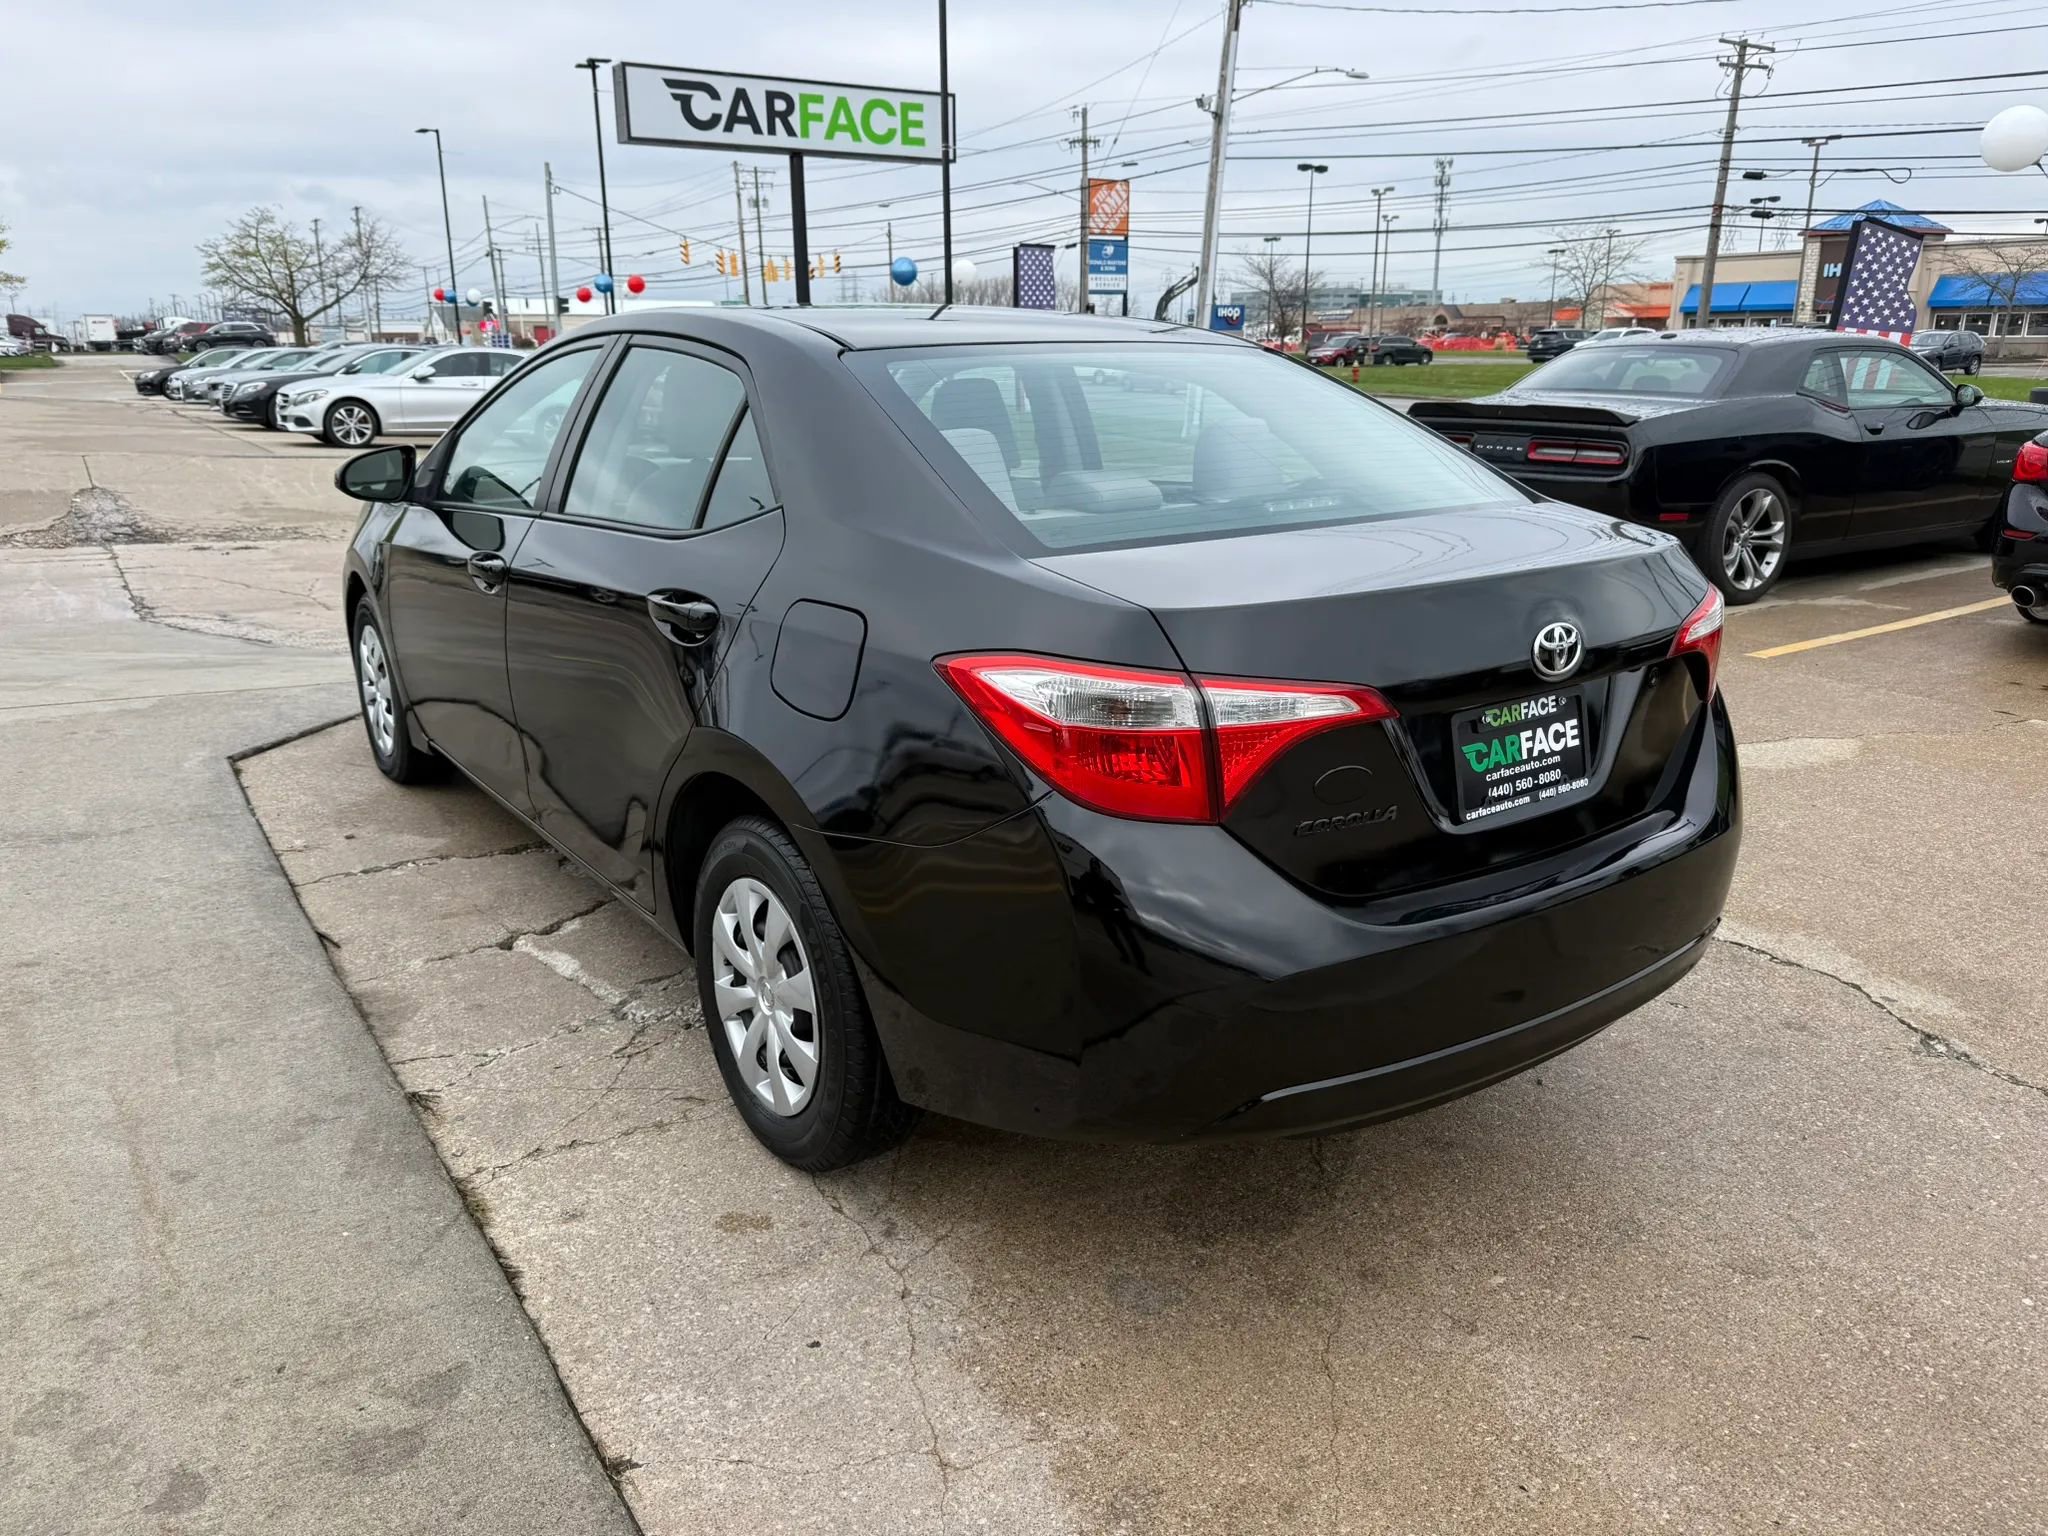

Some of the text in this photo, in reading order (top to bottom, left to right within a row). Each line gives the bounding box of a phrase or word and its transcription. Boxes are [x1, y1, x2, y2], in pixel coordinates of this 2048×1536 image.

[661, 77, 926, 148] CARFACE
[1088, 181, 1128, 234] HOME
[1823, 262, 1842, 278] IH
[1217, 306, 1241, 320] IHOP
[1485, 695, 1557, 727] CARFACE
[1461, 718, 1580, 773] CARFACE
[1486, 755, 1561, 782] carfaceauto.com
[1466, 795, 1531, 821] carfaceauto.com
[1538, 787, 1557, 801] (440)
[1488, 782, 1513, 798] (440)
